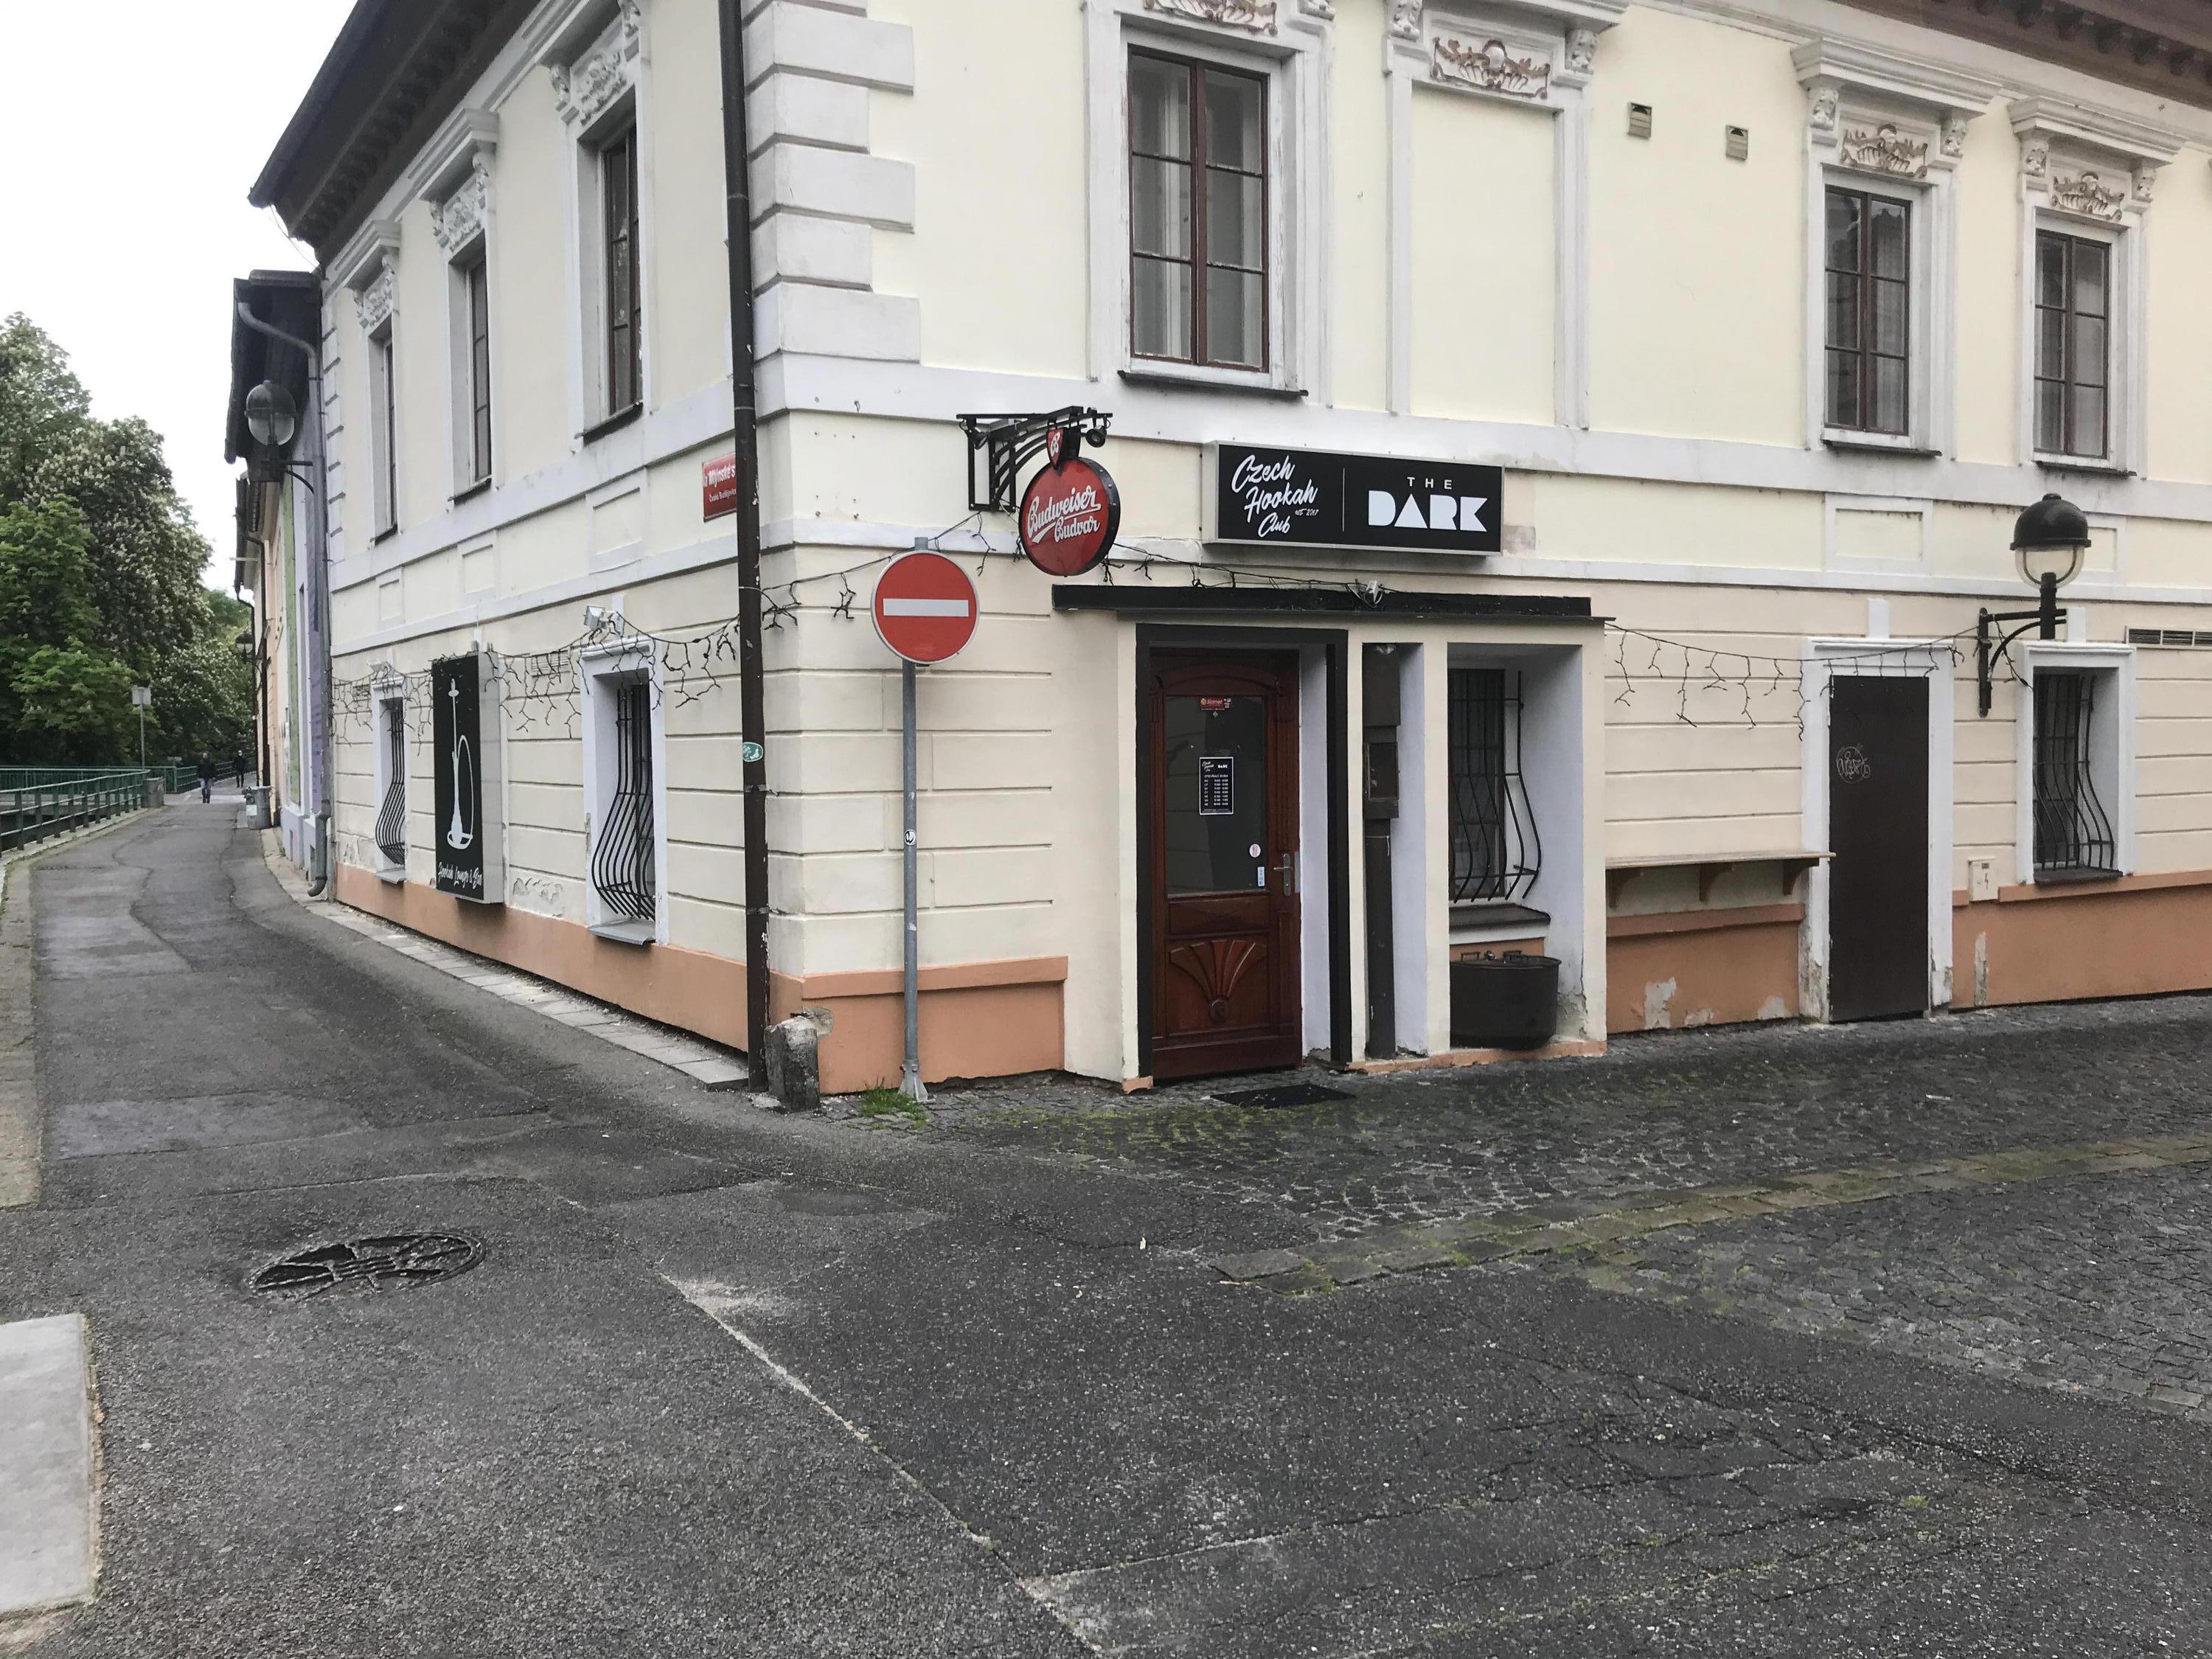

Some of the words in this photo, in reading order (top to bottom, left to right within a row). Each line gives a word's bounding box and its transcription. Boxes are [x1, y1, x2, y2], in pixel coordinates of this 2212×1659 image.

[1231, 454, 1295, 493] Czech
[1407, 476, 1453, 490] THE
[1027, 484, 1102, 538] Budweiser
[1244, 479, 1318, 524] Hookah
[1368, 490, 1488, 532] DARK
[1054, 515, 1100, 543] Budvar
[1258, 512, 1291, 538] Club
